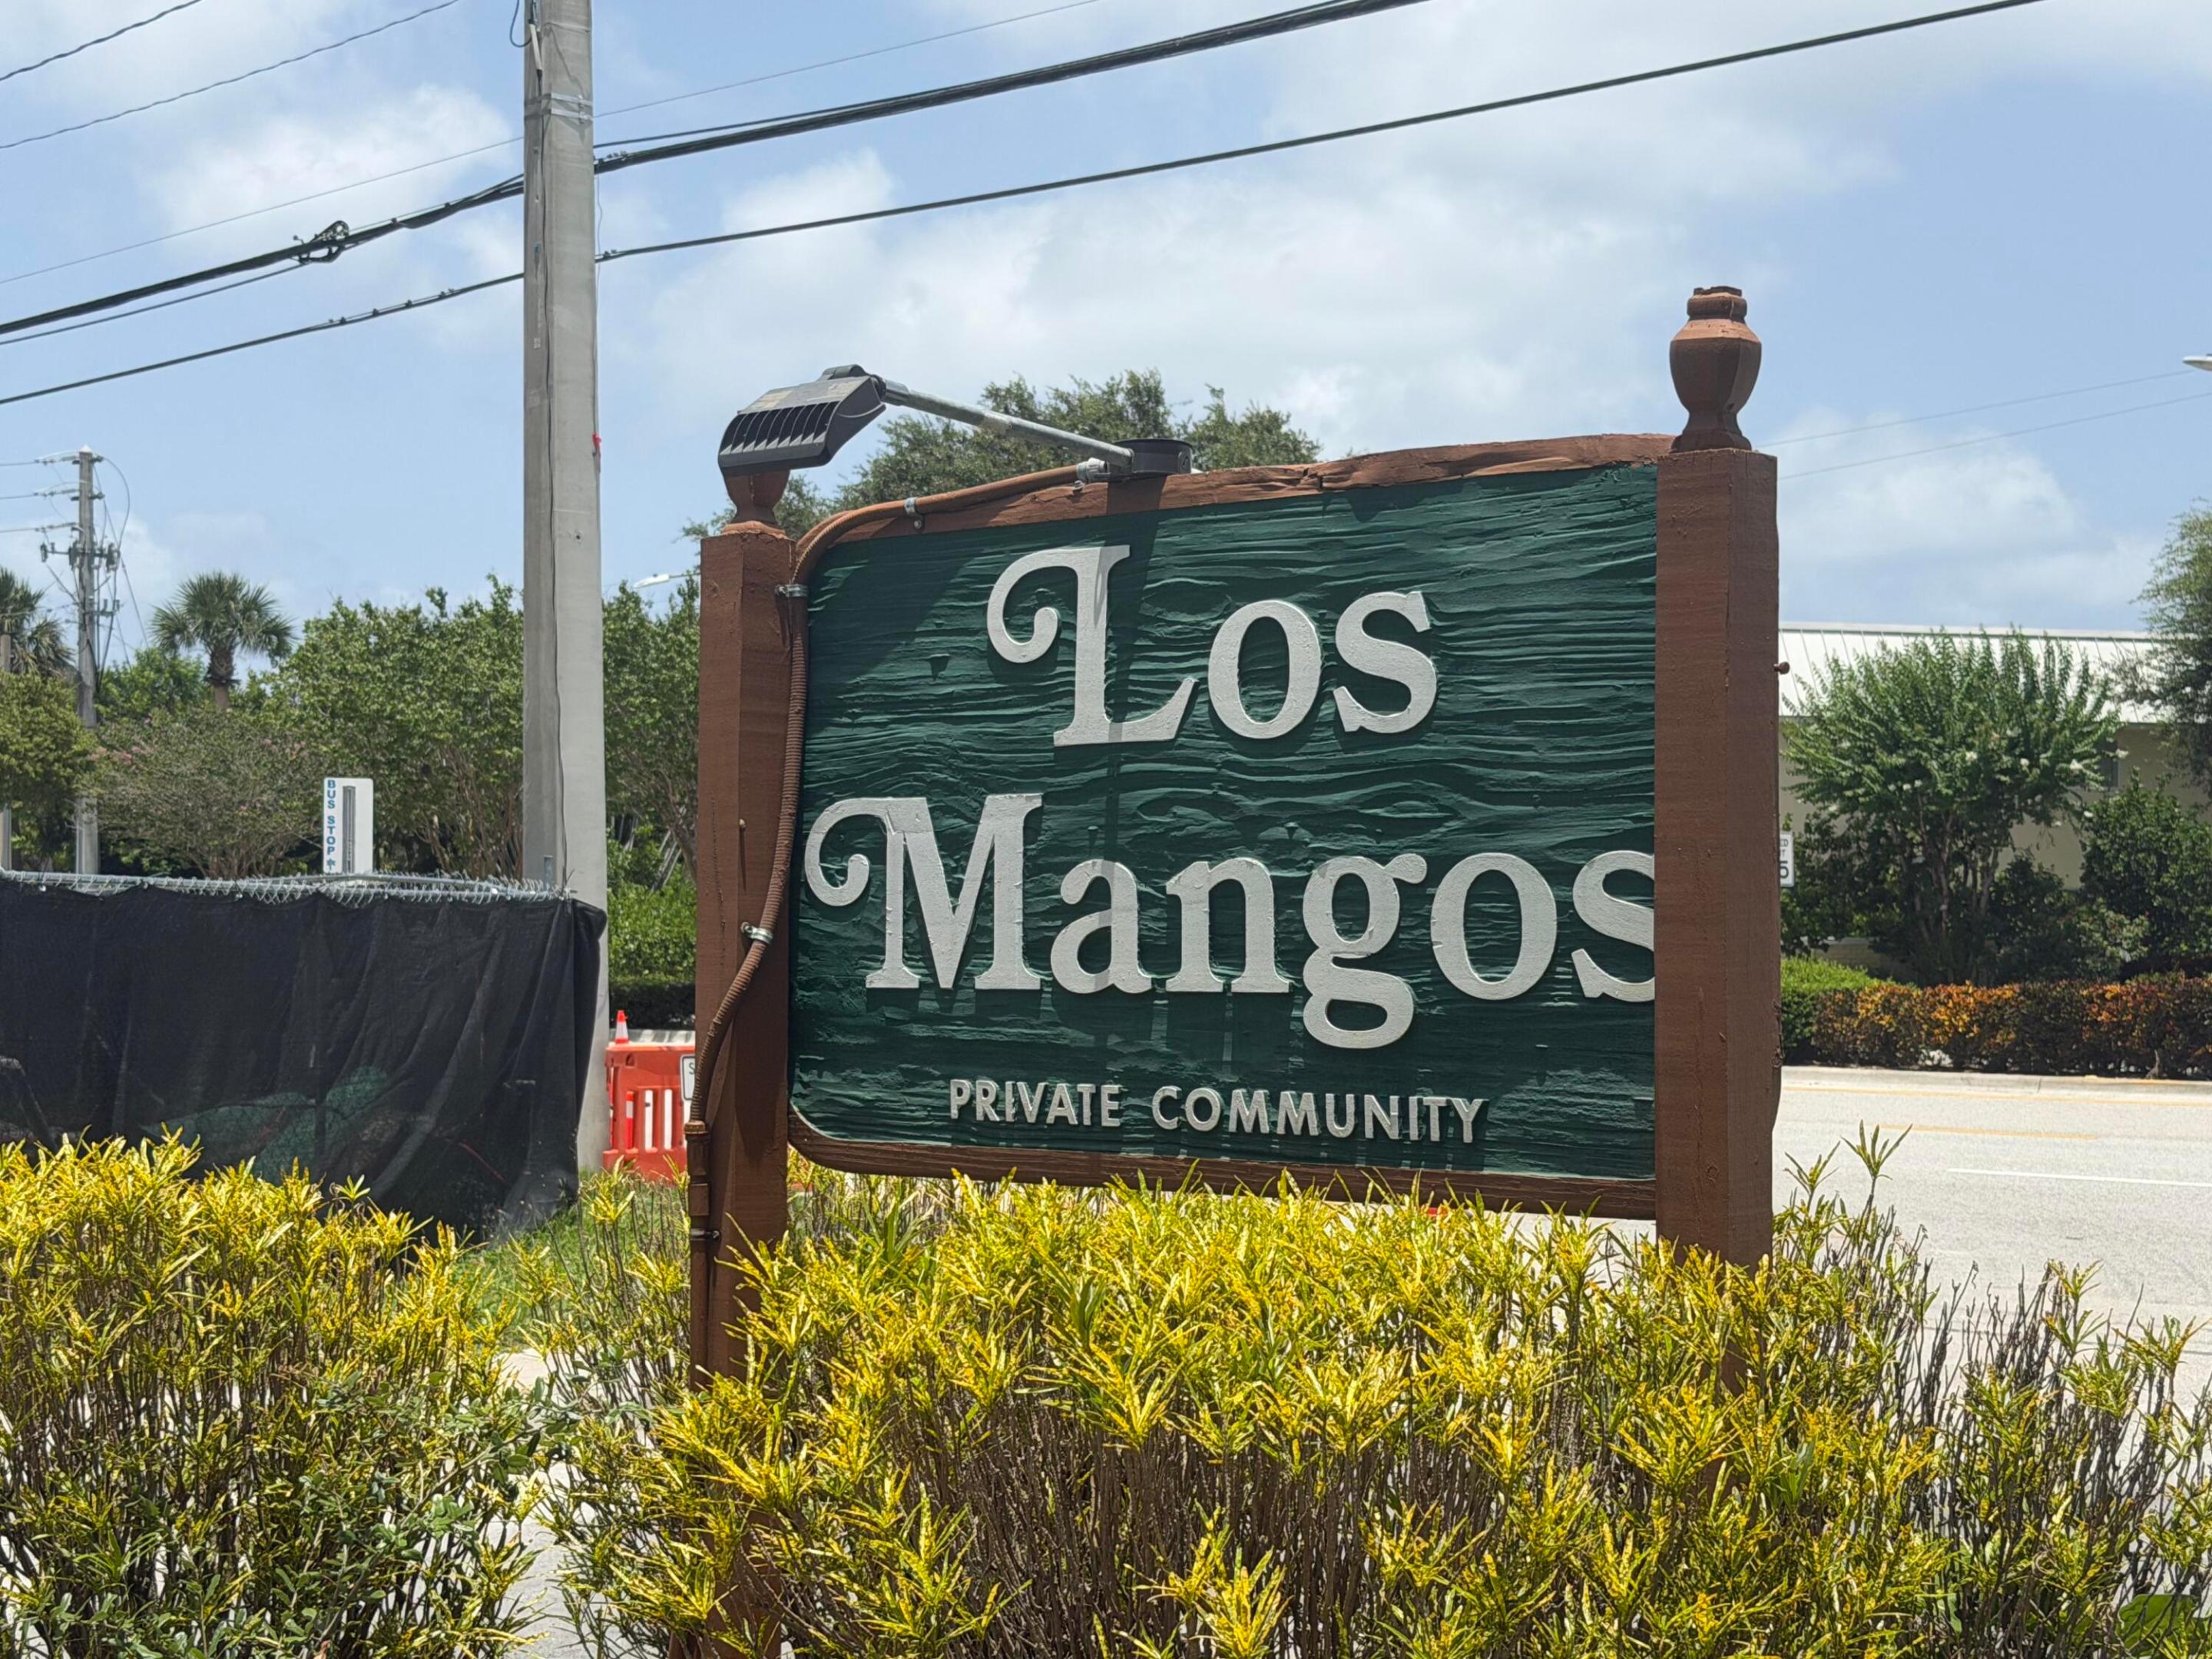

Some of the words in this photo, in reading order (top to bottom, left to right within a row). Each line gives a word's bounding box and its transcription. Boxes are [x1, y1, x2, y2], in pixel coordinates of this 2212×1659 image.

[987, 545, 1438, 746] Los
[327, 780, 336, 809] BUS
[326, 816, 335, 855] STOP
[804, 793, 1654, 1048] Mangos
[949, 1078, 1122, 1128] PRIVATE
[1152, 1084, 1488, 1143] COMMUNITY
